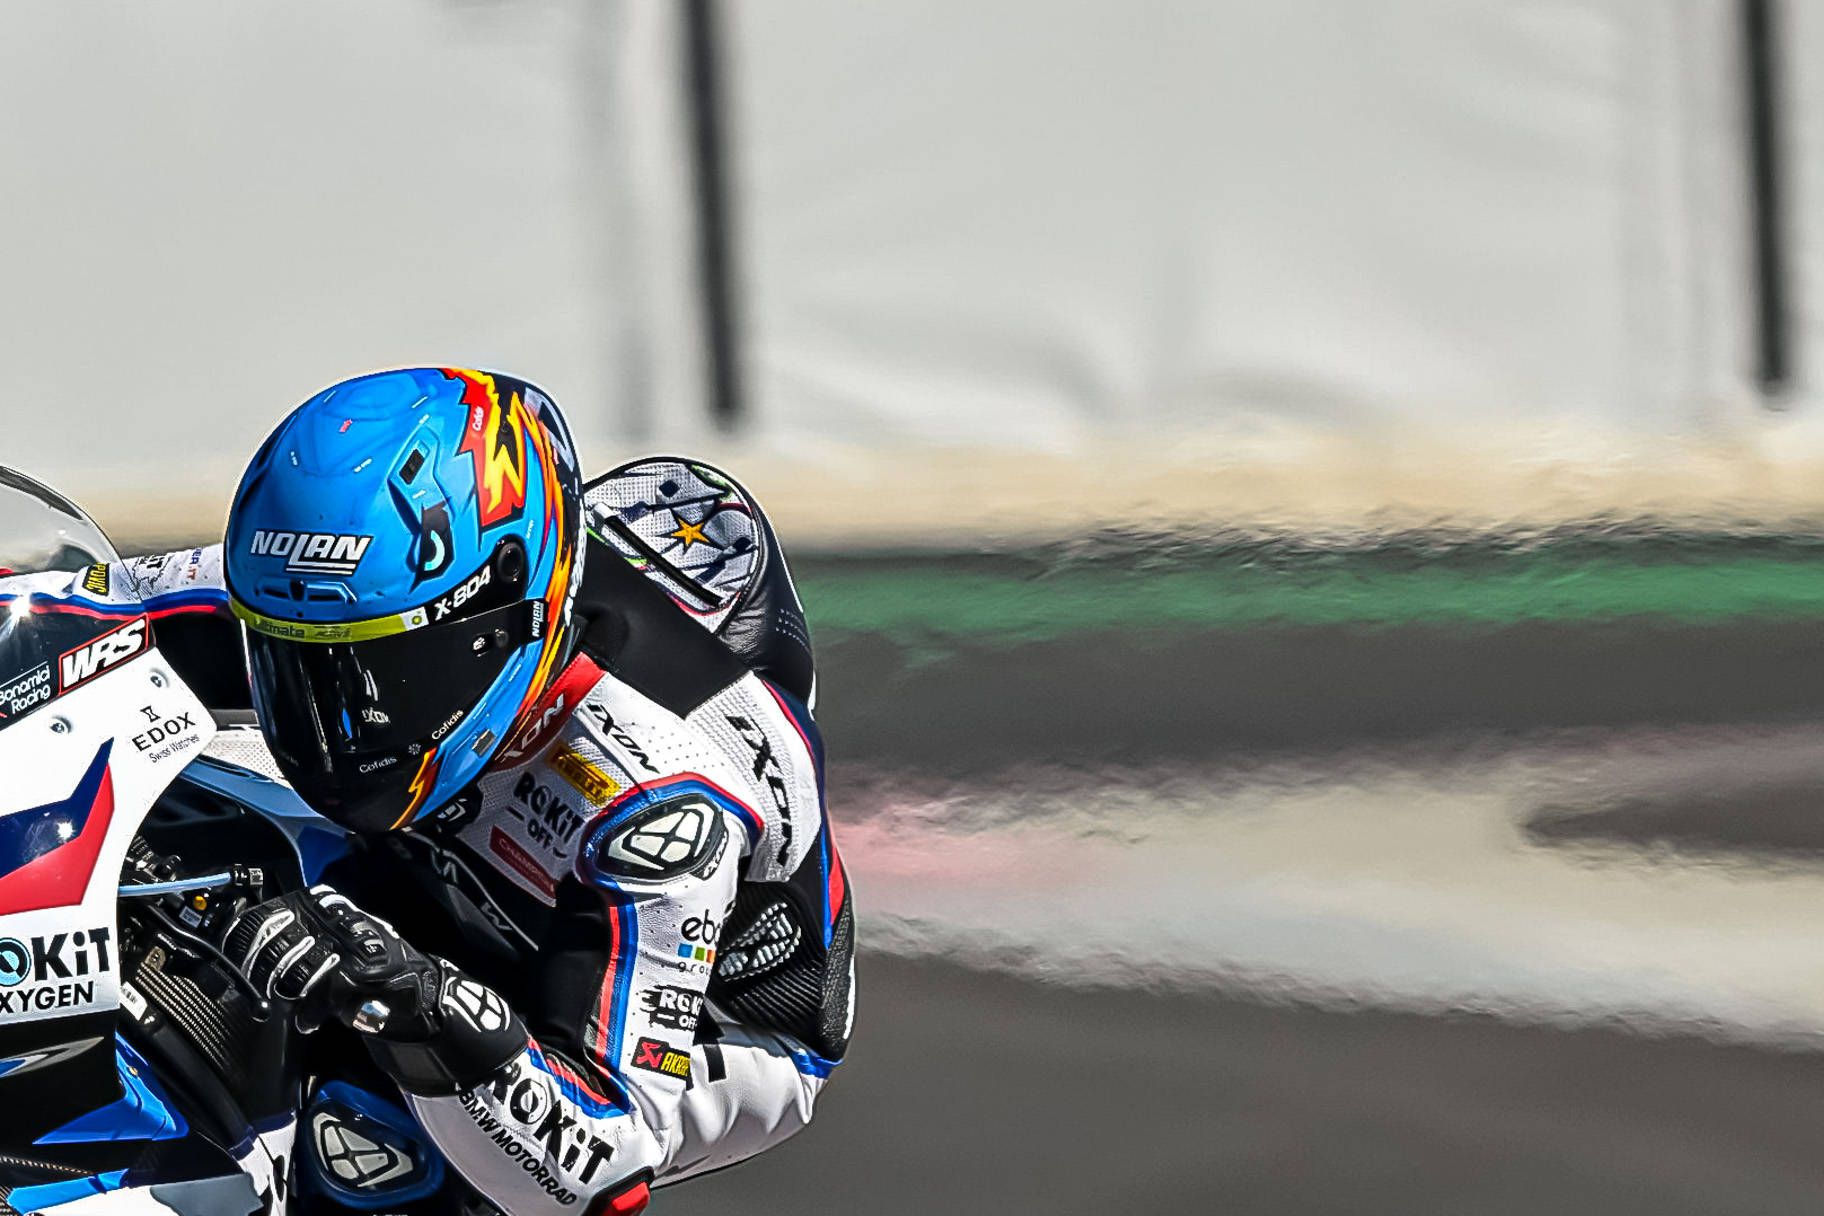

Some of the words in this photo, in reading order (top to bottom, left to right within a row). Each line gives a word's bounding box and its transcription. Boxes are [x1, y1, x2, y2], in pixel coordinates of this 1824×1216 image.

[250, 530, 372, 570] NOLAN
[434, 565, 492, 621] X-804
[531, 600, 545, 637] NOLAN
[60, 617, 147, 689] WRS
[11, 684, 52, 716] Racing
[131, 711, 197, 752] EDOX
[431, 709, 464, 740] Cofidis
[586, 701, 660, 774] IXON
[359, 756, 398, 774] Cofidis
[513, 770, 586, 844] ROKiT
[526, 818, 554, 849] OFF
[681, 908, 722, 945] eb
[458, 1089, 502, 1134] BMW
[491, 1127, 578, 1206] MOTORRAD
